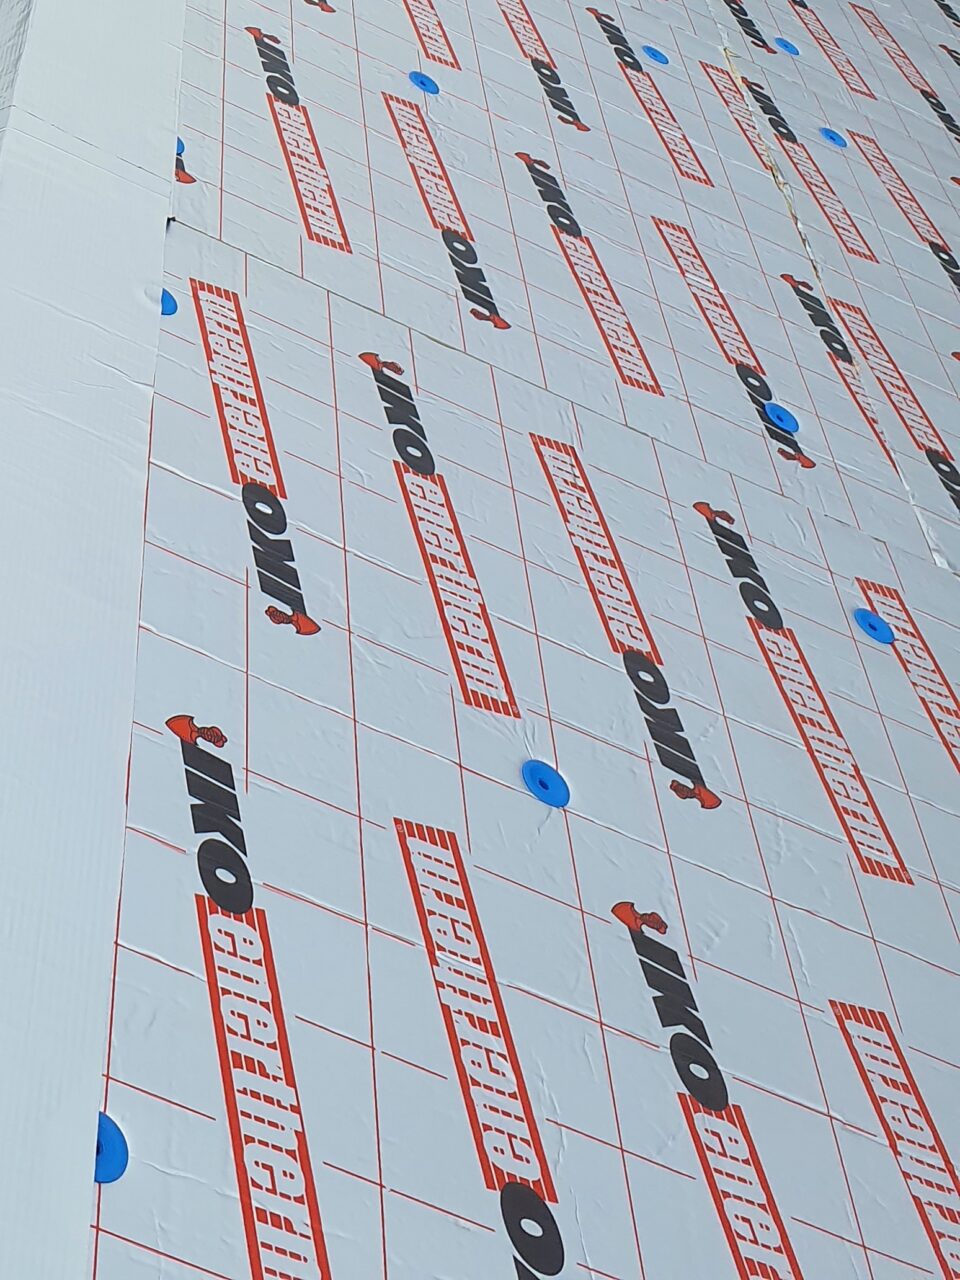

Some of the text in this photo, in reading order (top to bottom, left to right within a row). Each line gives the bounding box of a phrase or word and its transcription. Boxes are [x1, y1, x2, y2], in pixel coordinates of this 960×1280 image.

[254, 34, 348, 250] IKO enertherm
[530, 60, 581, 123] IKO
[594, 14, 711, 185] IKO enertherm
[789, 1, 876, 99] enertherm
[385, 93, 498, 316] IKO enertherm
[744, 83, 798, 141] IKO
[776, 135, 877, 261] enertherm
[848, 130, 950, 250] enertherm
[526, 161, 659, 393] IKO enertherm
[655, 218, 763, 373] enertherm
[789, 286, 853, 365] IKO
[195, 284, 305, 613] IKO enertherm
[830, 299, 952, 459] enertherm
[371, 367, 516, 711] IKO enertherm
[534, 437, 707, 790] IKO enertherm
[705, 516, 909, 880] IKO enertherm
[181, 738, 255, 912] IKO
[399, 825, 550, 1197] enertherm
[629, 927, 730, 1112] IKO
[833, 1004, 960, 1280] rtherm
